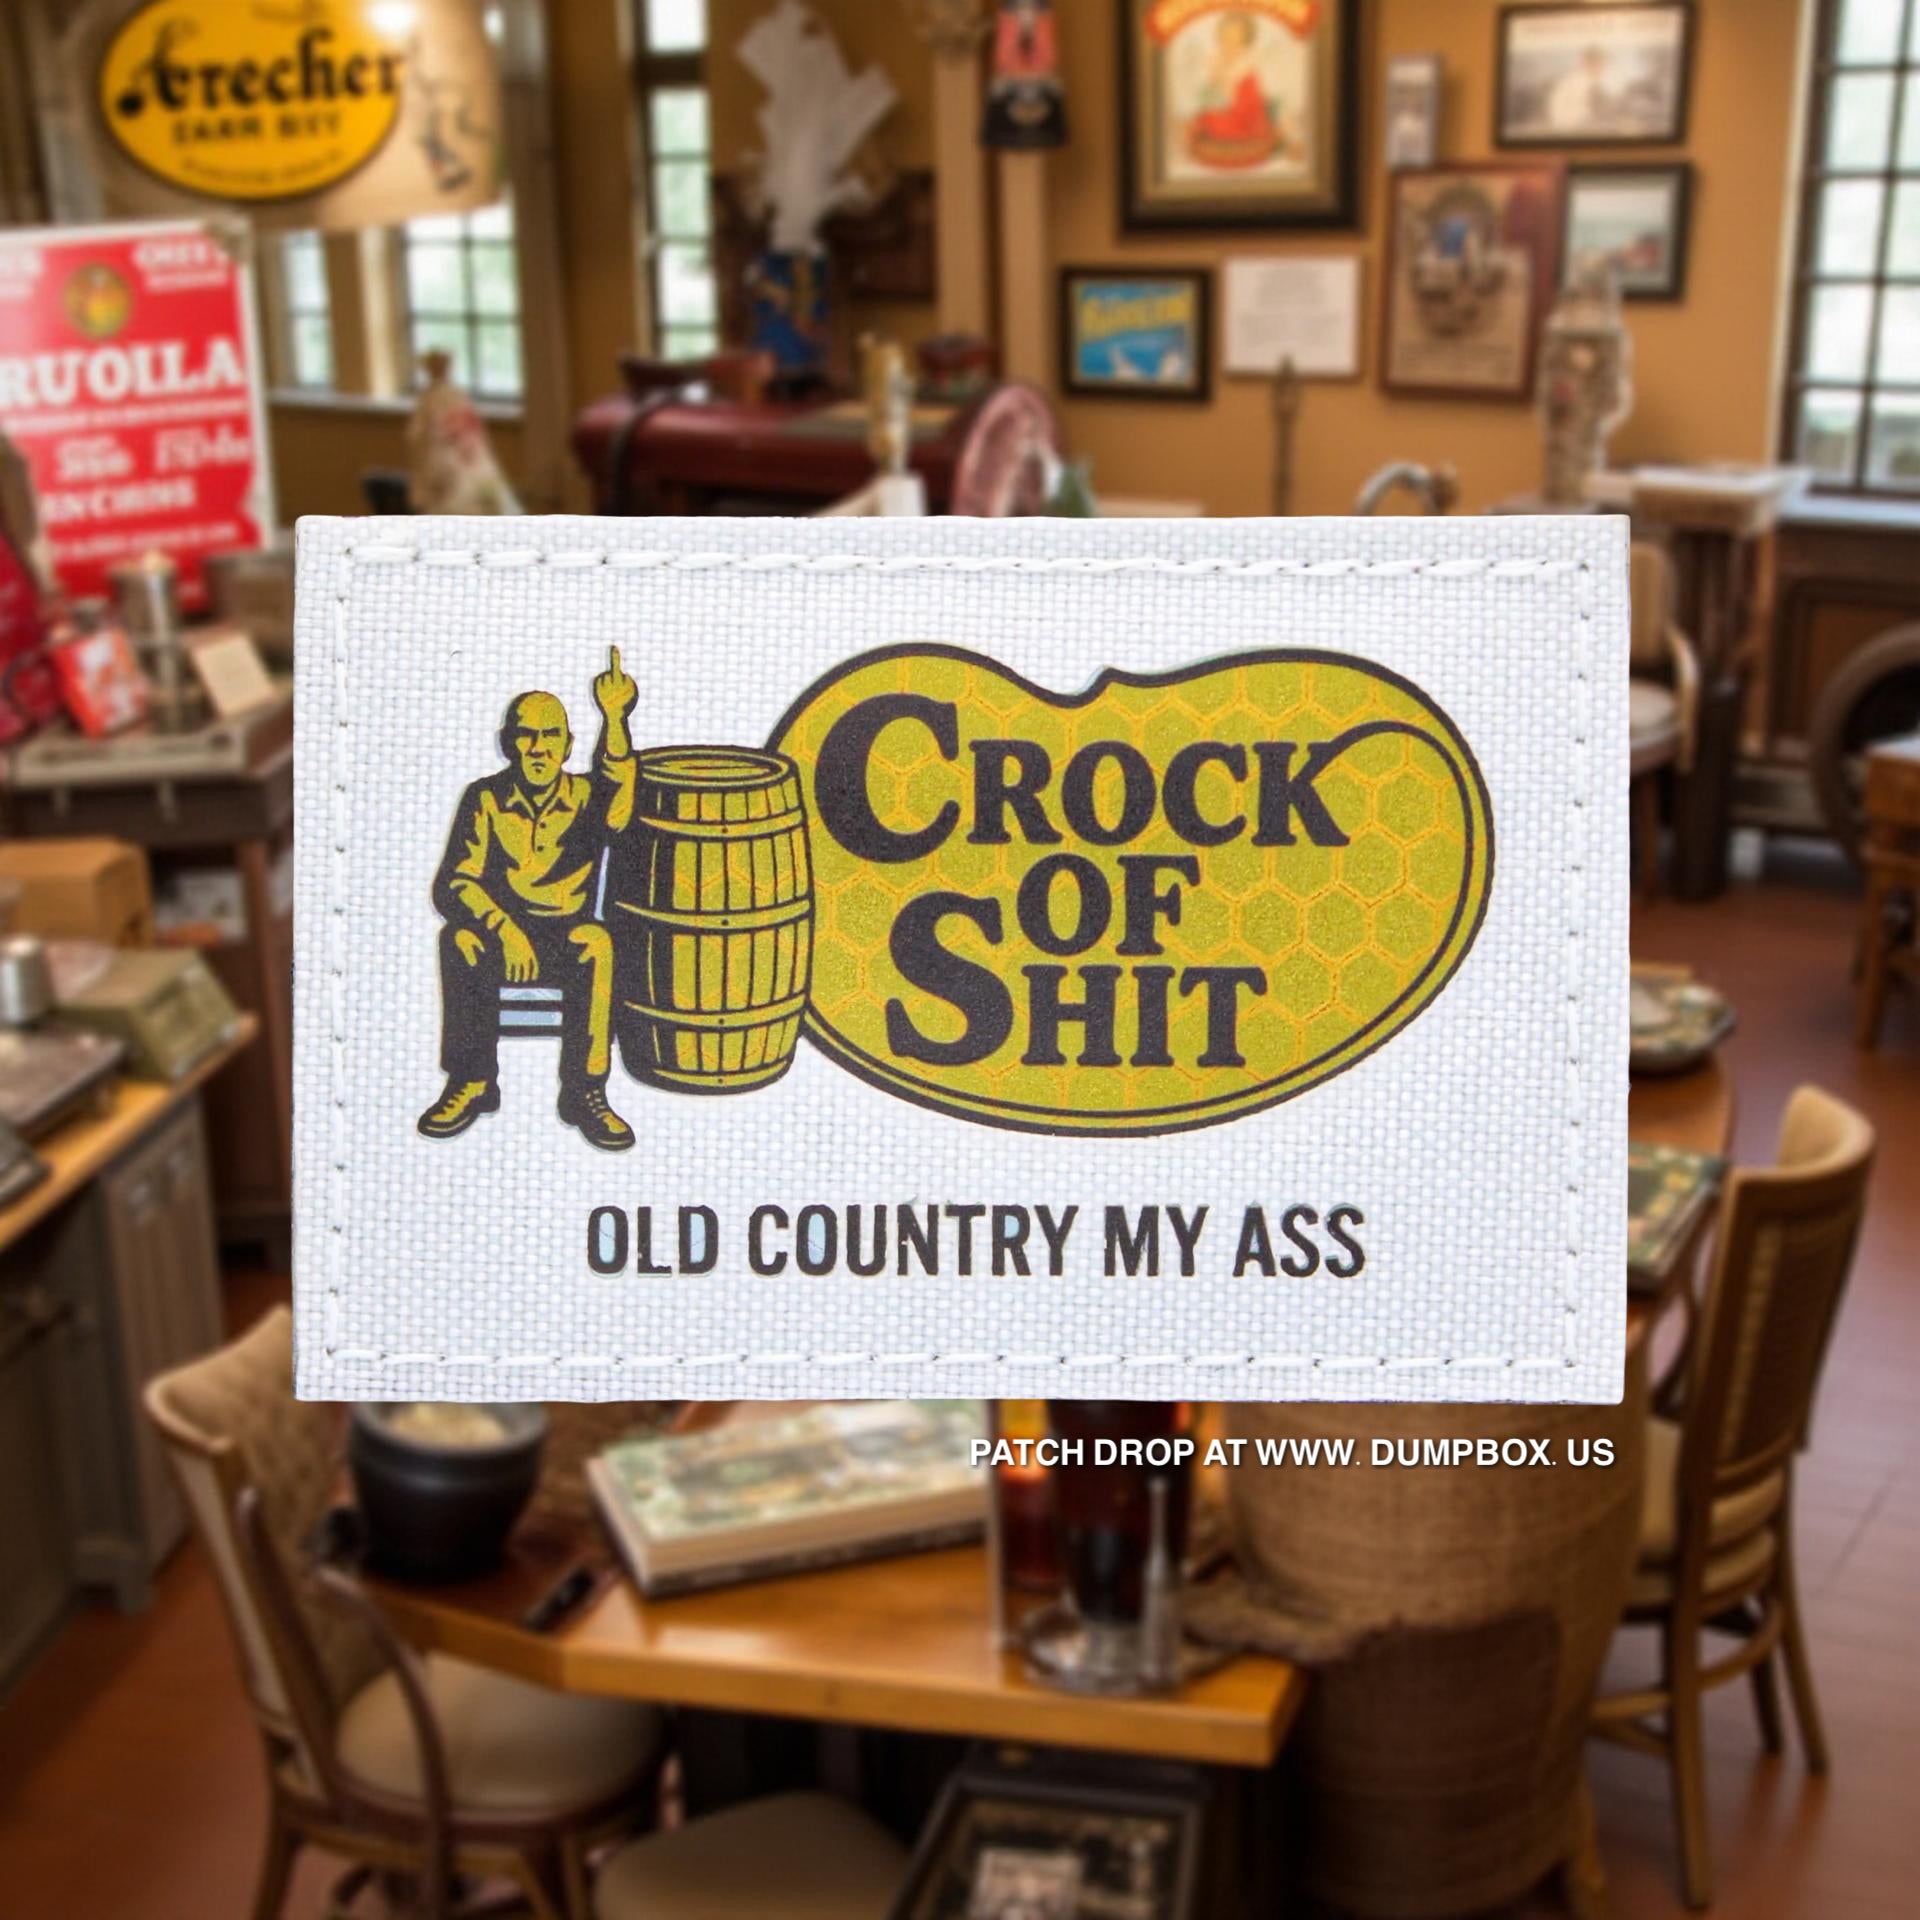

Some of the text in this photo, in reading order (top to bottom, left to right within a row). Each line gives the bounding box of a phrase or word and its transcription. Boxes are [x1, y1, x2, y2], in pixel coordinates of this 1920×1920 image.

[814, 692, 1351, 863] CROCK
[1016, 853, 1200, 956] OF
[886, 890, 1268, 1067] SHIT
[587, 1203, 1366, 1279] OLD COUNTRY MY ASS
